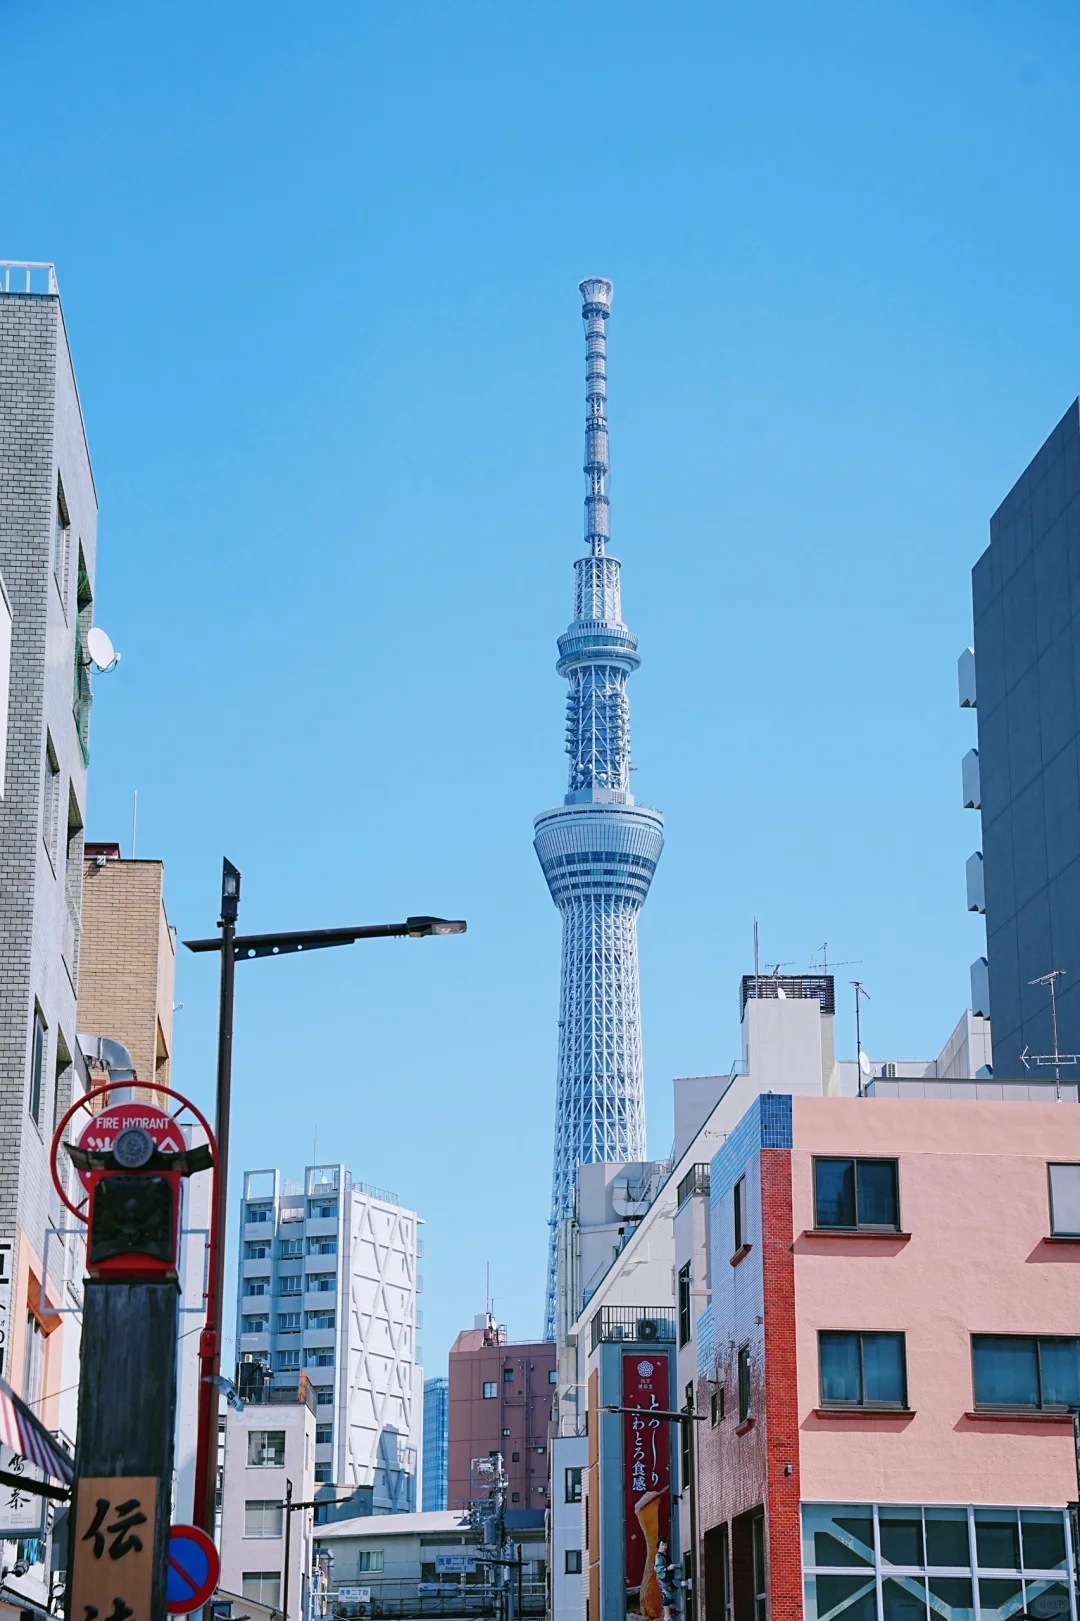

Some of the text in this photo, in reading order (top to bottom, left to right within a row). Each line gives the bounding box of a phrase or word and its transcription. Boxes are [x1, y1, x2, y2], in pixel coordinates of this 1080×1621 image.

[96, 1117, 170, 1129] FIRE HYDRANT
[437, 1556, 474, 1566] 浅草二丁目
